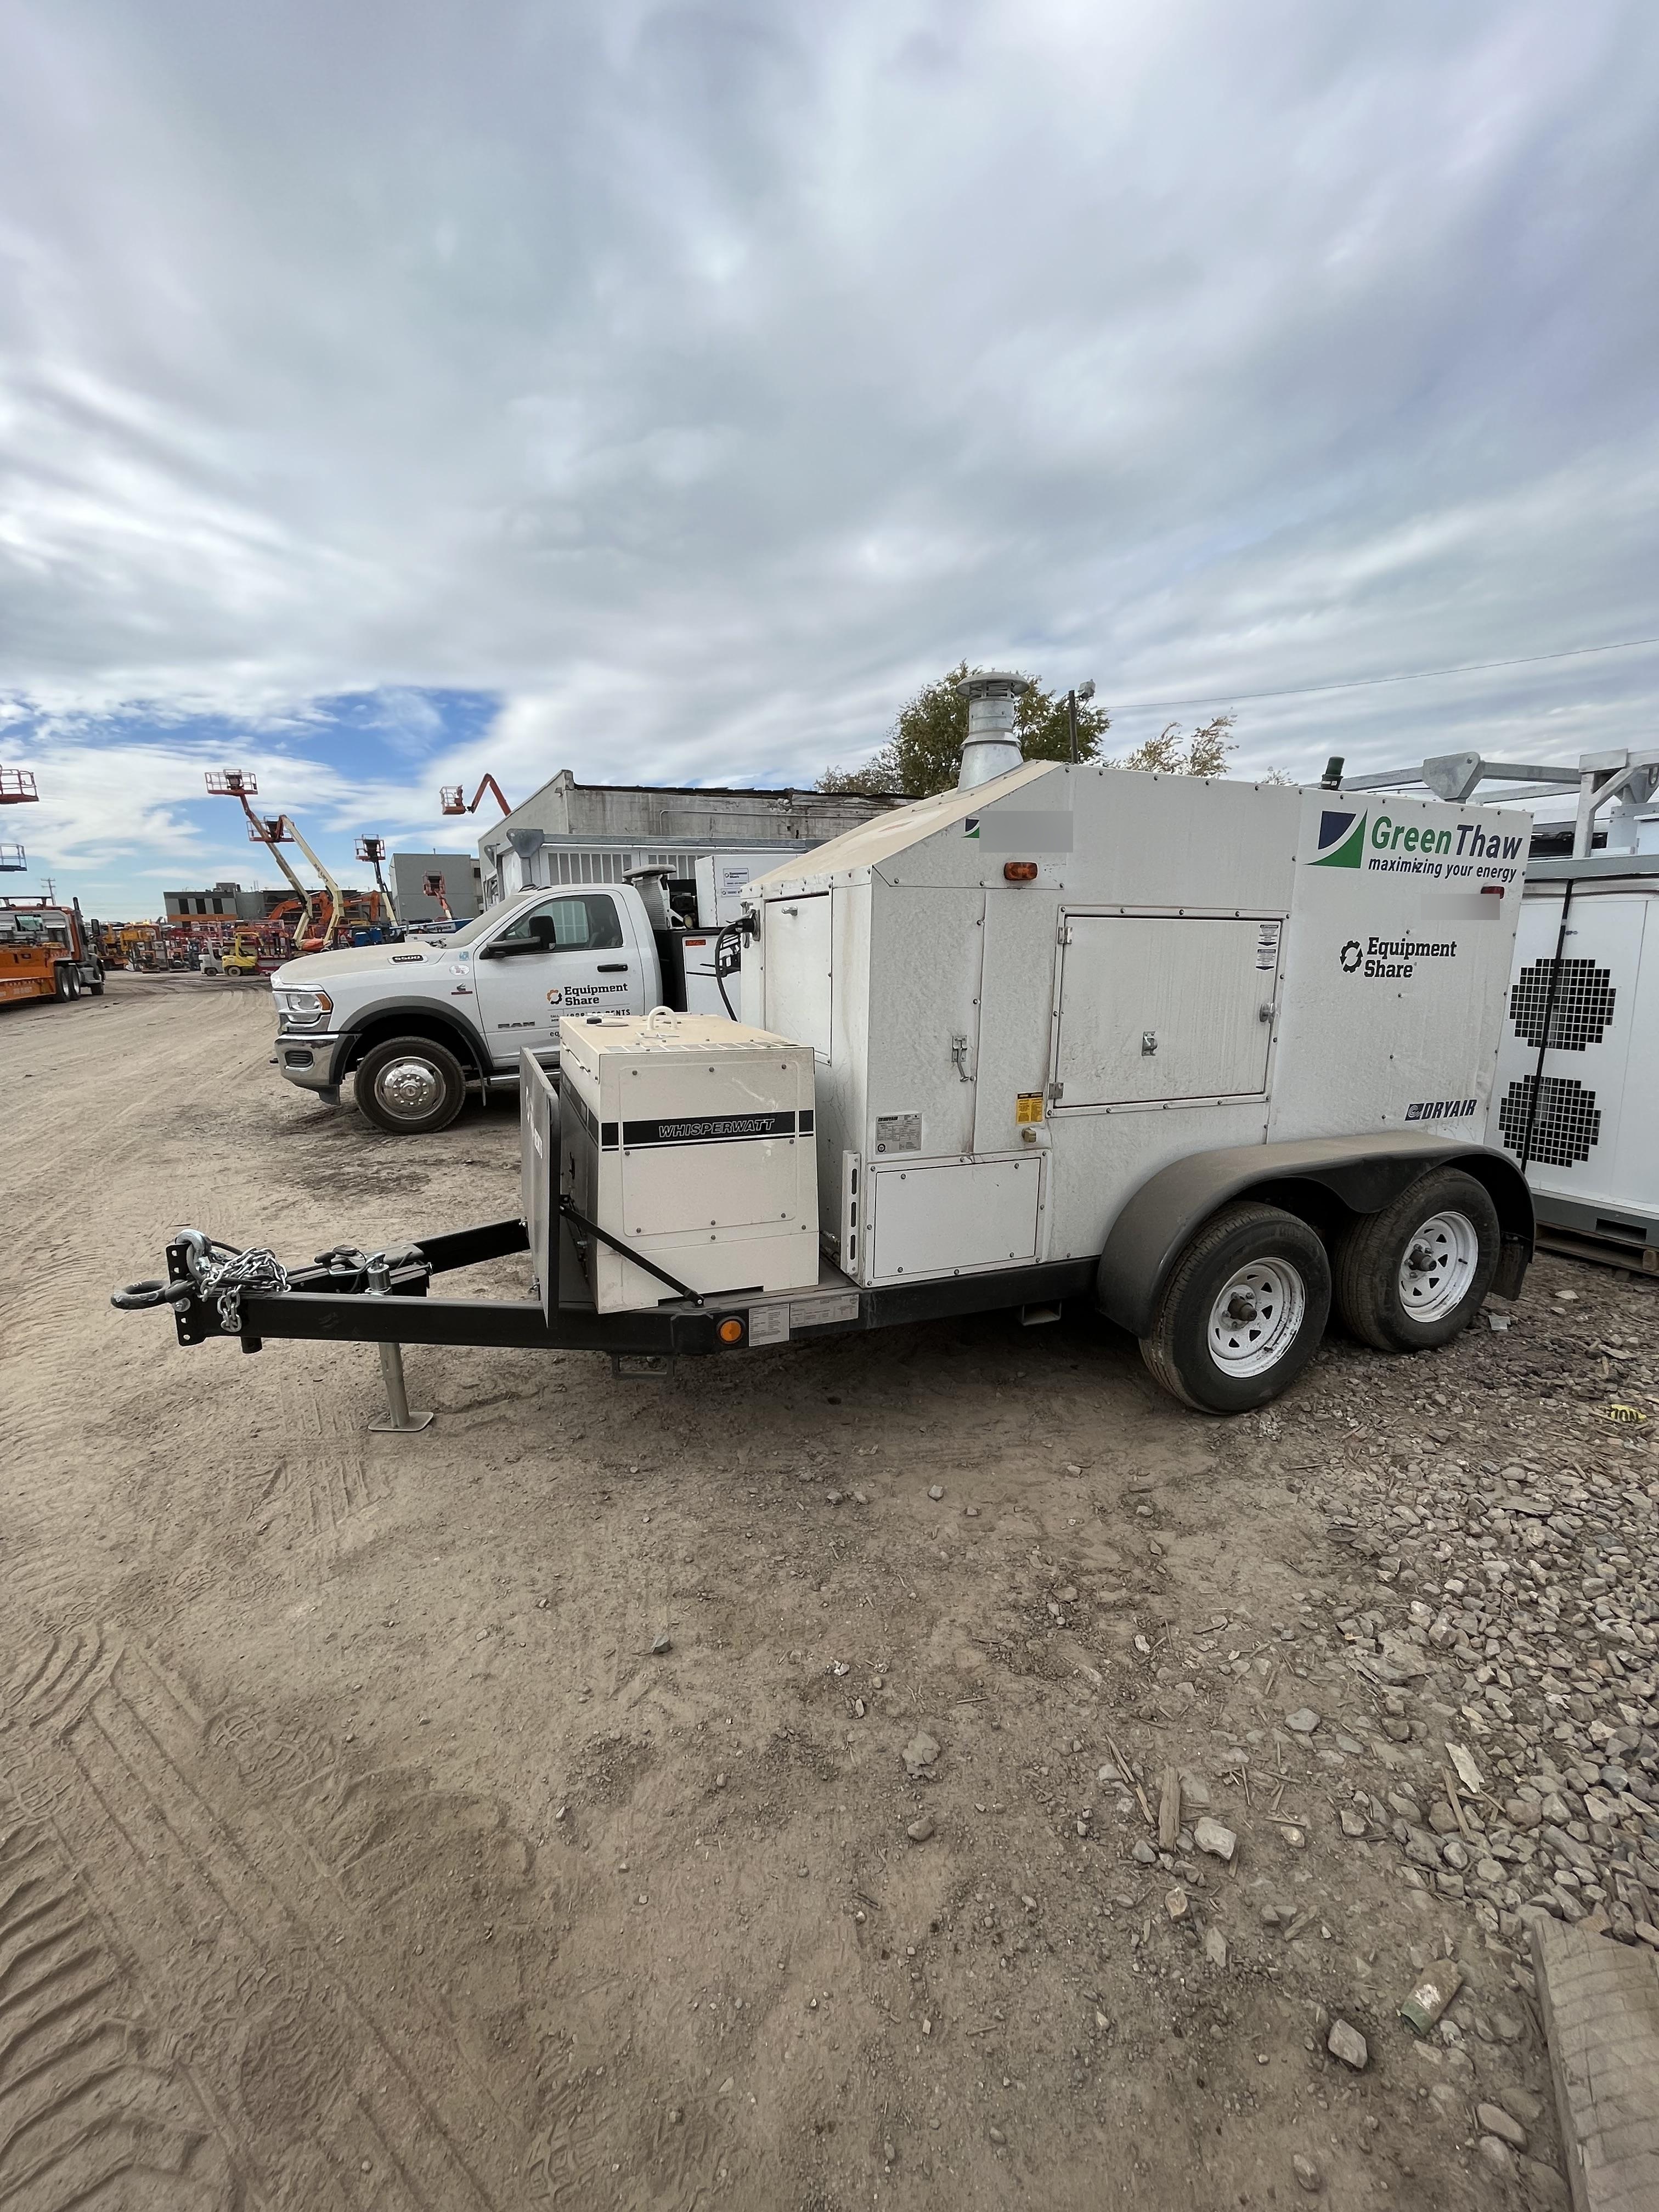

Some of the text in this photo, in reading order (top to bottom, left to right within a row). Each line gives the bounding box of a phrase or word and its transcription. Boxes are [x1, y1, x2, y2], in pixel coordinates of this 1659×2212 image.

[1368, 856, 1517, 883] maximizing your energy
[1367, 936, 1457, 960] Equipment
[1364, 960, 1413, 978] Share
[564, 983, 628, 996] Equipment
[565, 996, 600, 1006] Share
[1421, 1099, 1477, 1120] DRYAIR
[659, 1119, 775, 1137] WHISPERWATT
